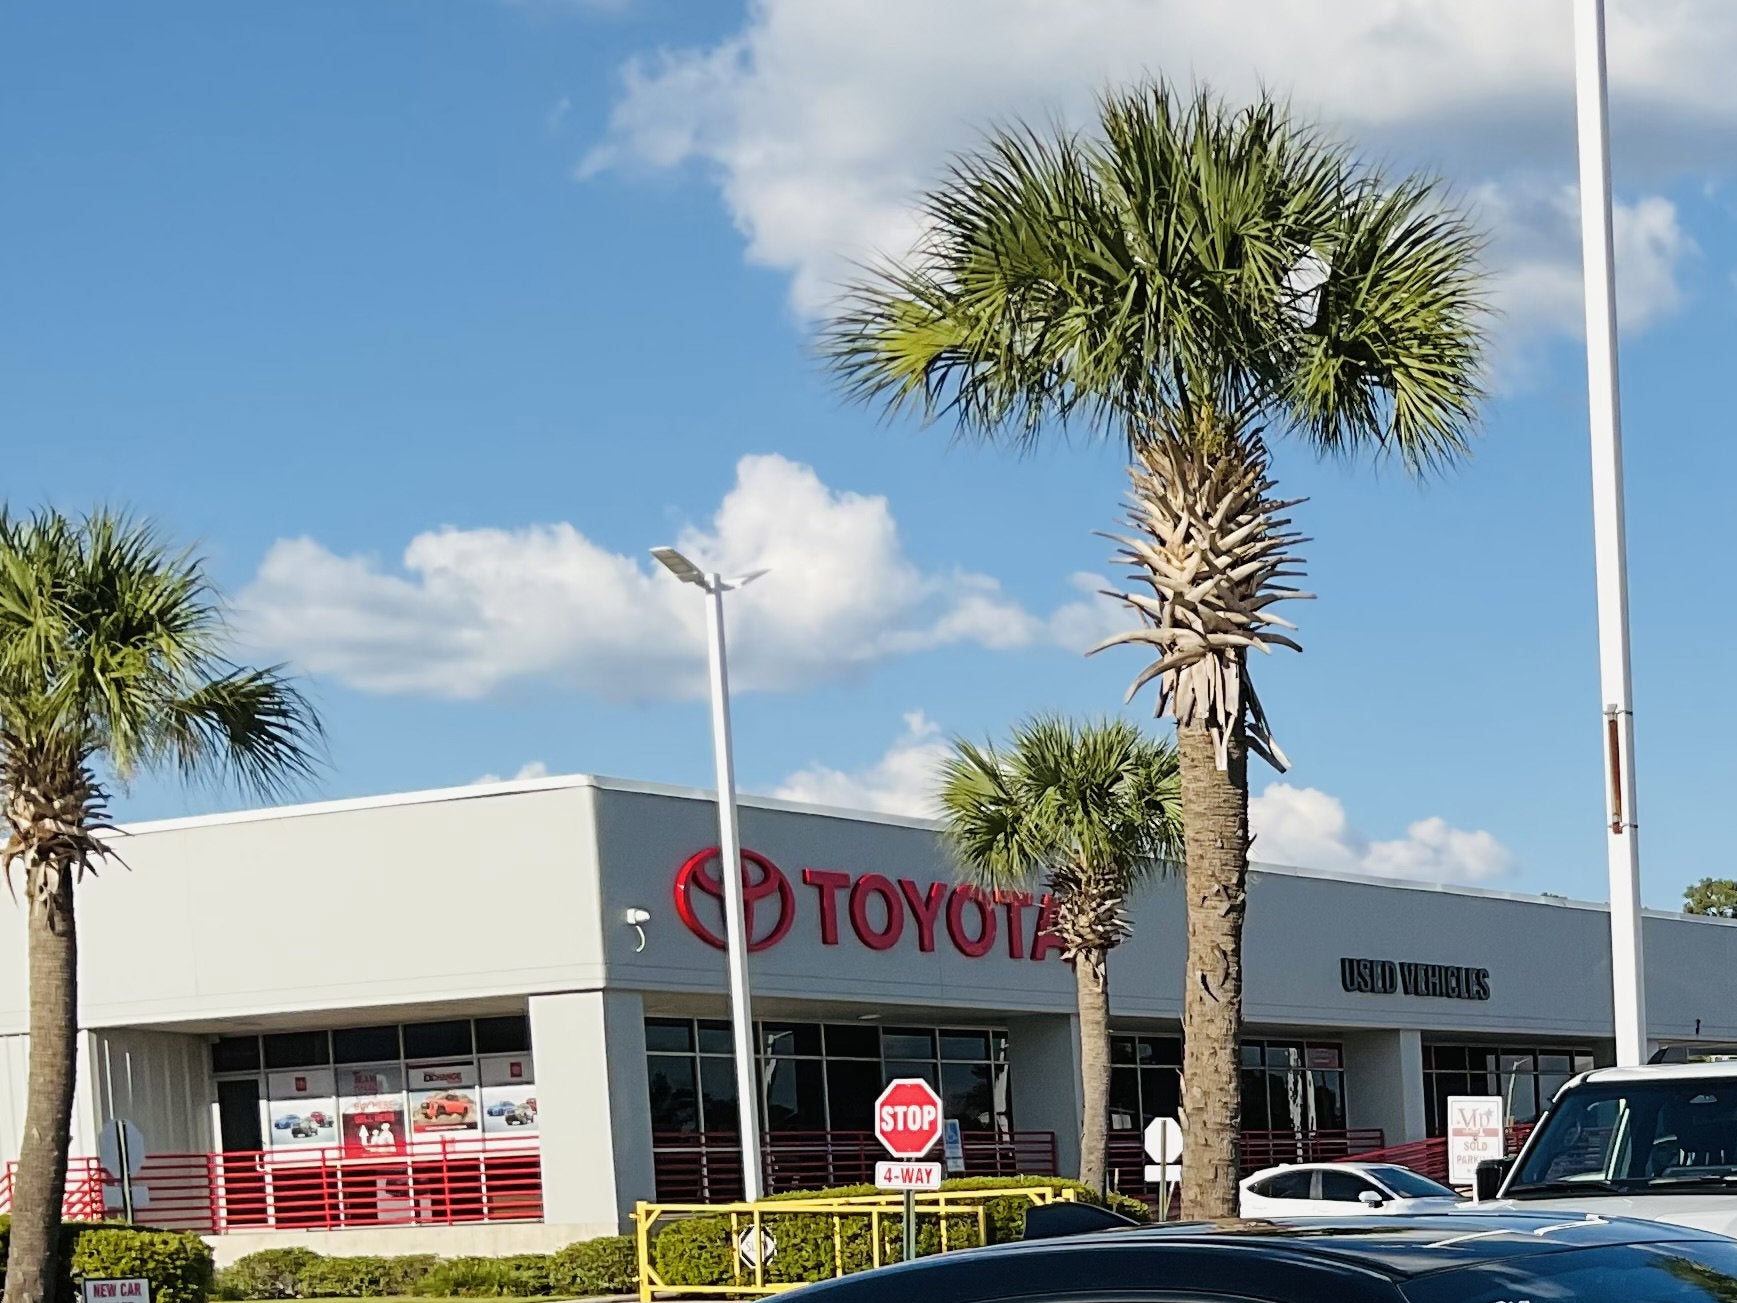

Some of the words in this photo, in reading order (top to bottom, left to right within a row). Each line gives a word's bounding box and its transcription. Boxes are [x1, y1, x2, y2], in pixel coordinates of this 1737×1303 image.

[1341, 958, 1397, 993] USED
[1399, 962, 1490, 1000] VEHICLES
[881, 1104, 936, 1132] STOP
[1464, 1141, 1488, 1151] SOLD
[884, 1168, 933, 1184] 4-WAY
[93, 1284, 117, 1297] NEW
[120, 1282, 142, 1296] CAR
